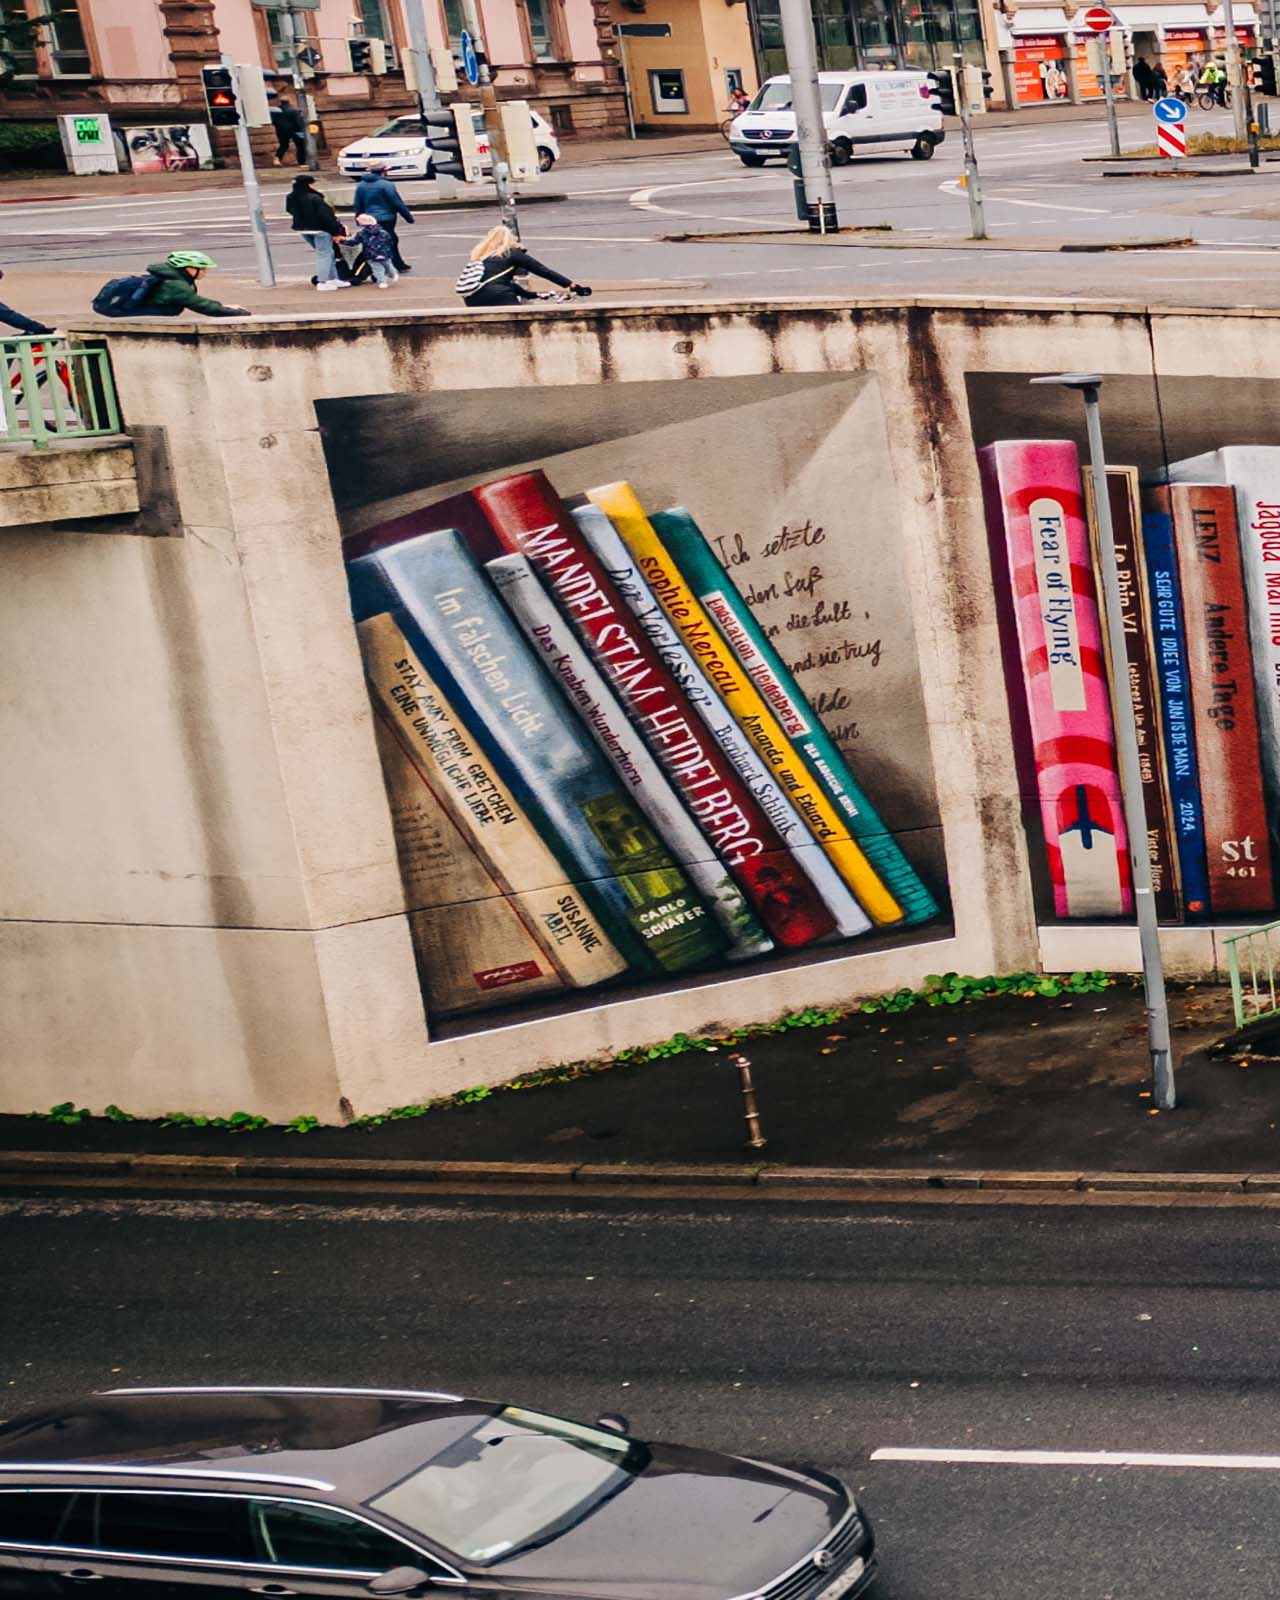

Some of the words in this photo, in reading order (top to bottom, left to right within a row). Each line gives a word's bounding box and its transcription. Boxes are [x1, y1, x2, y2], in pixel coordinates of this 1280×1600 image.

[713, 533, 750, 570] Ich
[760, 519, 826, 558] setzte
[1038, 516, 1062, 565] Fear
[1192, 508, 1222, 564] LENZ
[745, 584, 779, 606] den
[1046, 572, 1071, 593] of
[1155, 571, 1173, 600] SEHR
[786, 611, 811, 632] die
[1044, 598, 1078, 667] Flying
[1158, 599, 1177, 632] GUTE
[838, 639, 881, 668] trug
[1203, 601, 1233, 675] Andere
[434, 587, 464, 617] Im
[500, 691, 545, 739] Licht
[1165, 667, 1182, 693] VON
[553, 654, 594, 707] Knaben
[588, 702, 645, 788] Wunderhorn
[608, 566, 645, 604] Der
[713, 724, 758, 786] Bernhard
[752, 782, 799, 840] Schlink
[748, 663, 806, 737] Heidelberg
[1168, 699, 1185, 721] JAN
[1207, 679, 1239, 732] Tage
[393, 657, 426, 691] STAY
[417, 694, 449, 724] AWAY
[447, 727, 473, 761] FROM
[467, 763, 518, 825] GRETCHEN
[680, 619, 741, 697] Mereau
[742, 713, 783, 766] Amanda
[778, 768, 805, 796] und
[795, 792, 837, 839] Eduard
[1171, 721, 1185, 733] IS
[1173, 732, 1187, 748] DE
[390, 685, 420, 717] EINE
[463, 792, 497, 829] LIEBE
[646, 704, 765, 867] HEIDELBERG
[1147, 828, 1161, 861] Victor
[1221, 835, 1258, 862] st
[1226, 866, 1258, 878] 461
[540, 911, 575, 946] ABEL
[556, 895, 603, 954] SUSANNE
[639, 898, 686, 923] CARLO
